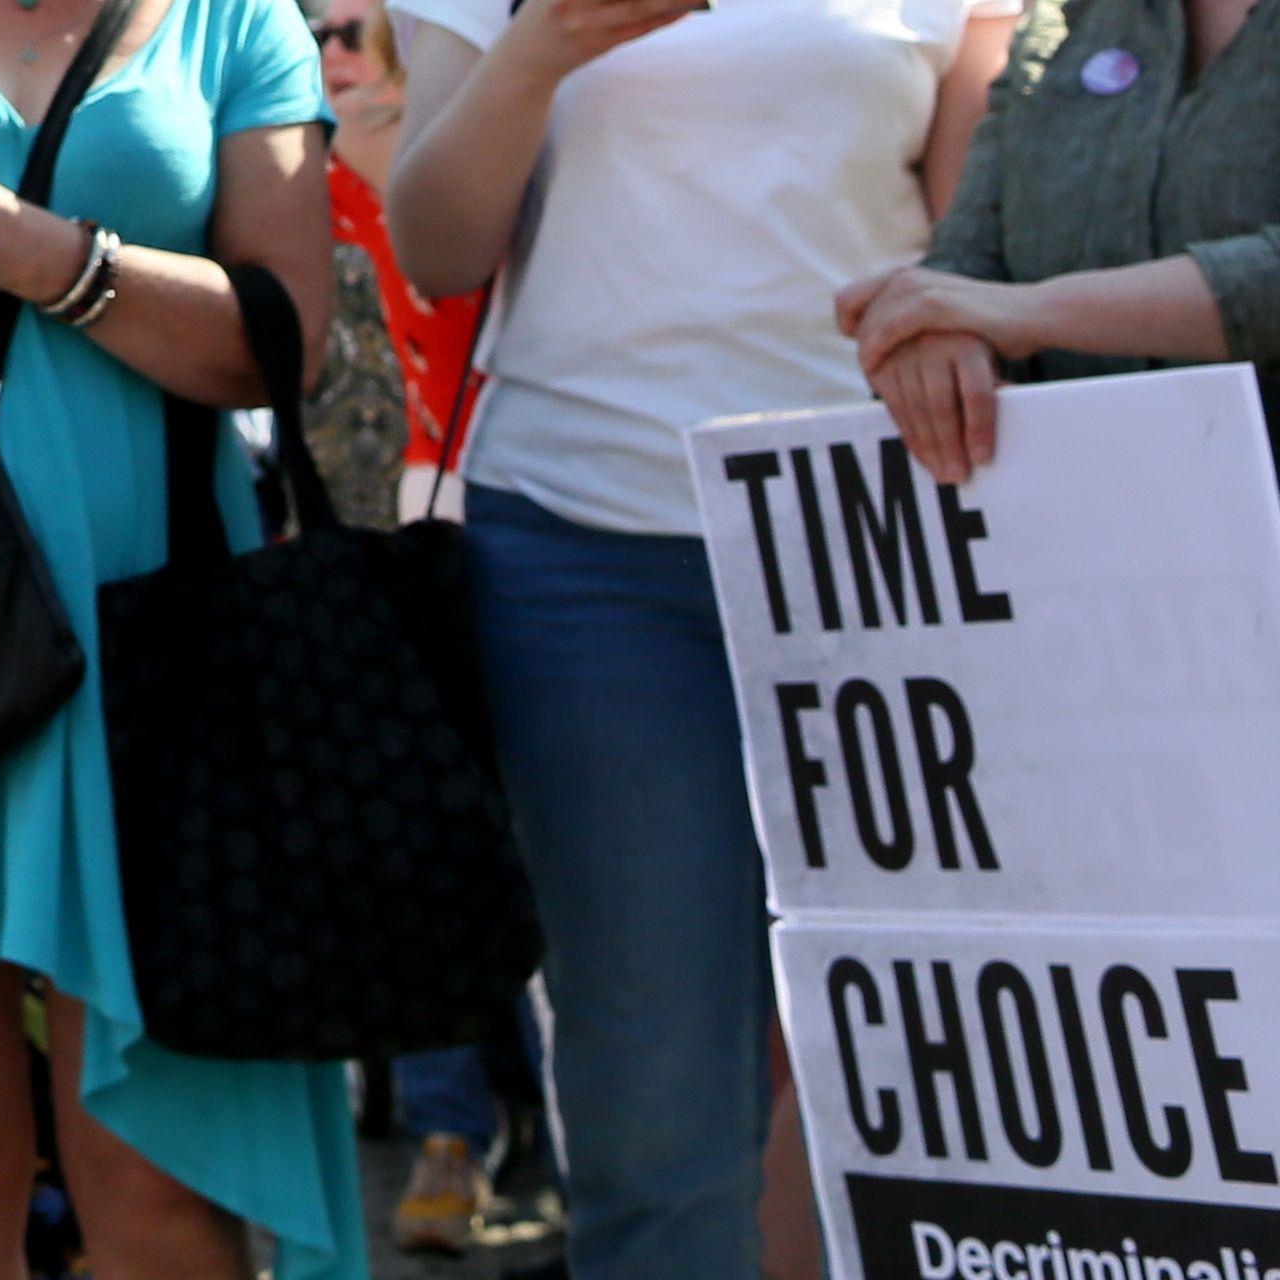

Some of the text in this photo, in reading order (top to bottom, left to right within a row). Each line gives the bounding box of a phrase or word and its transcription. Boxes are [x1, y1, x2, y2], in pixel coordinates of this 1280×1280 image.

[724, 435, 1014, 634] TIME
[775, 675, 1001, 873] FOR
[827, 954, 1279, 1185] CHOICE
